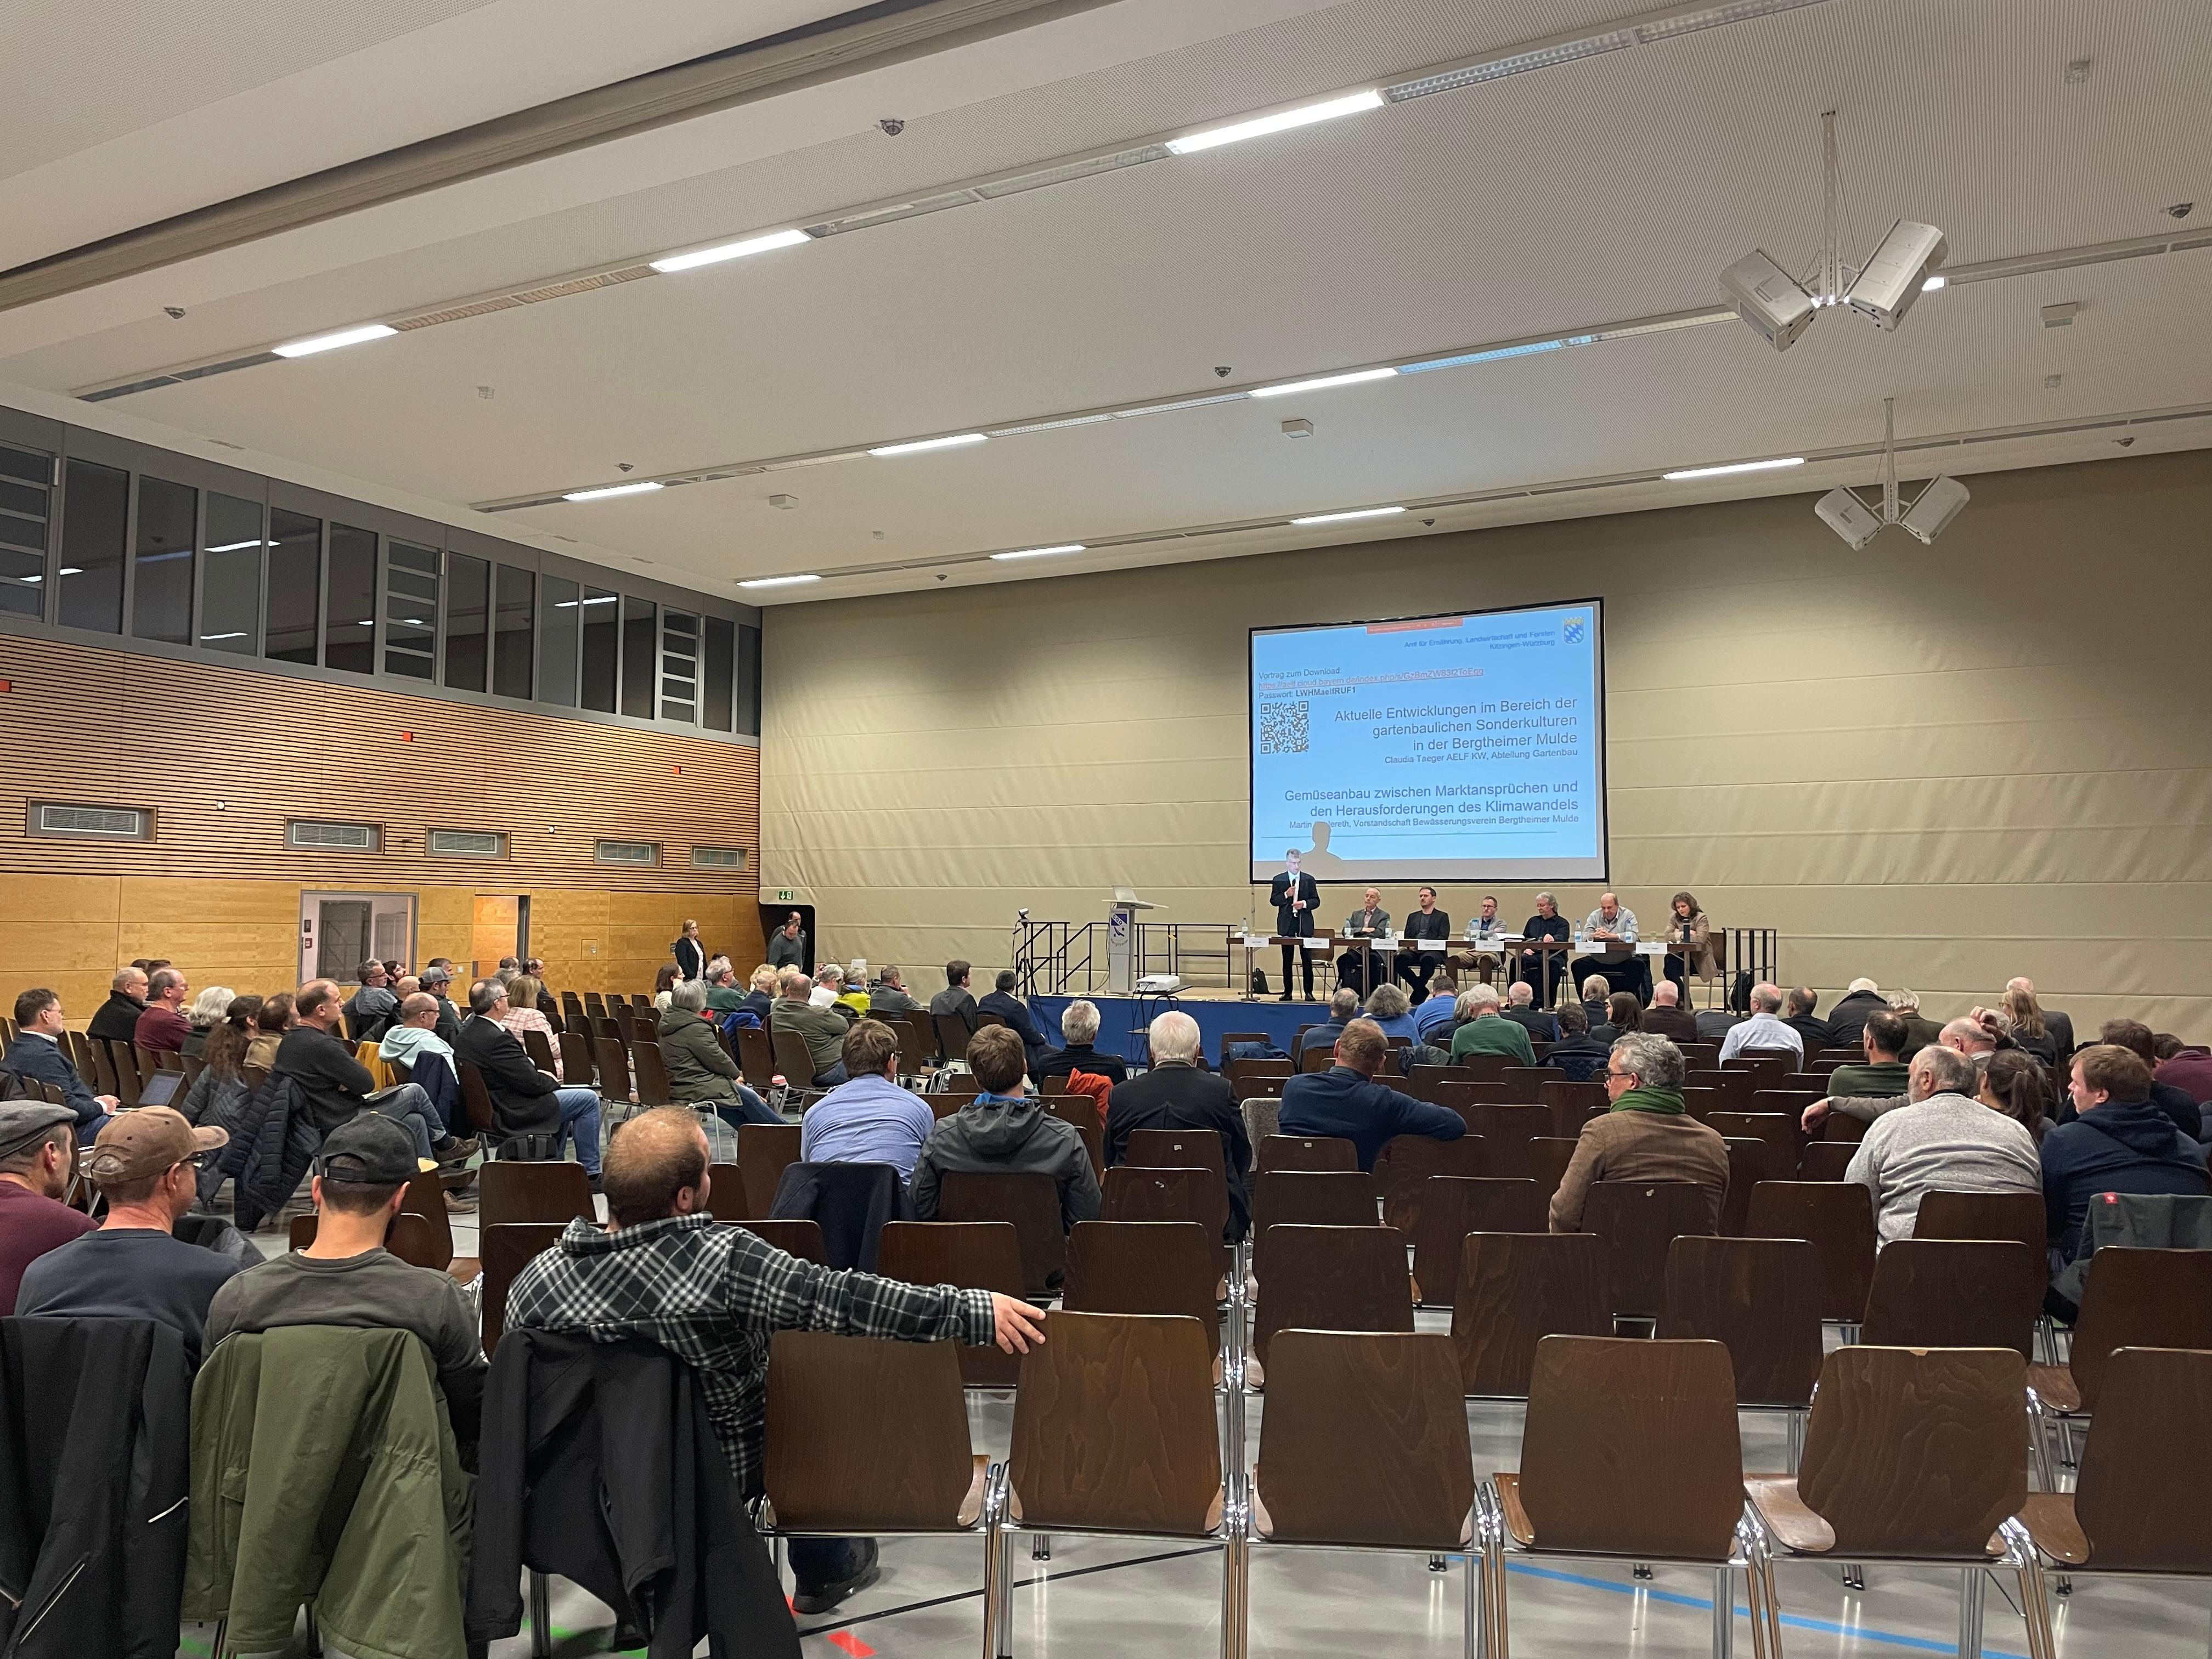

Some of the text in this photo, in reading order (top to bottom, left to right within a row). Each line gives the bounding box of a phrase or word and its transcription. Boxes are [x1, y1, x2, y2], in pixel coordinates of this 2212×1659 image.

[1466, 634, 1513, 643] Landwirtschaft
[1490, 640, 1555, 650] Kitzingen-Würzburg
[1304, 667, 1342, 676] Download:
[1334, 697, 1577, 722] Aktuelle Entwicklungen im Bereich der
[1373, 716, 1577, 739] gartenbaulichen Sonderkulturen
[1413, 732, 1577, 751] in der Bergtheimer Mulde
[1385, 749, 1578, 764] Claudia Taeger AELF KW, Abteilung Gartenbau
[1285, 780, 1578, 801] Gemüseanbau zwischen Marktansprüchen und
[1311, 799, 1578, 817] den Herausforderungen des Klimawandels
[1353, 818, 1410, 827] Vorstandschaft
[1413, 816, 1497, 826] Bewässerungsverein
[1499, 816, 1550, 825] Bergtheimer
[1553, 815, 1579, 823] Mulde
